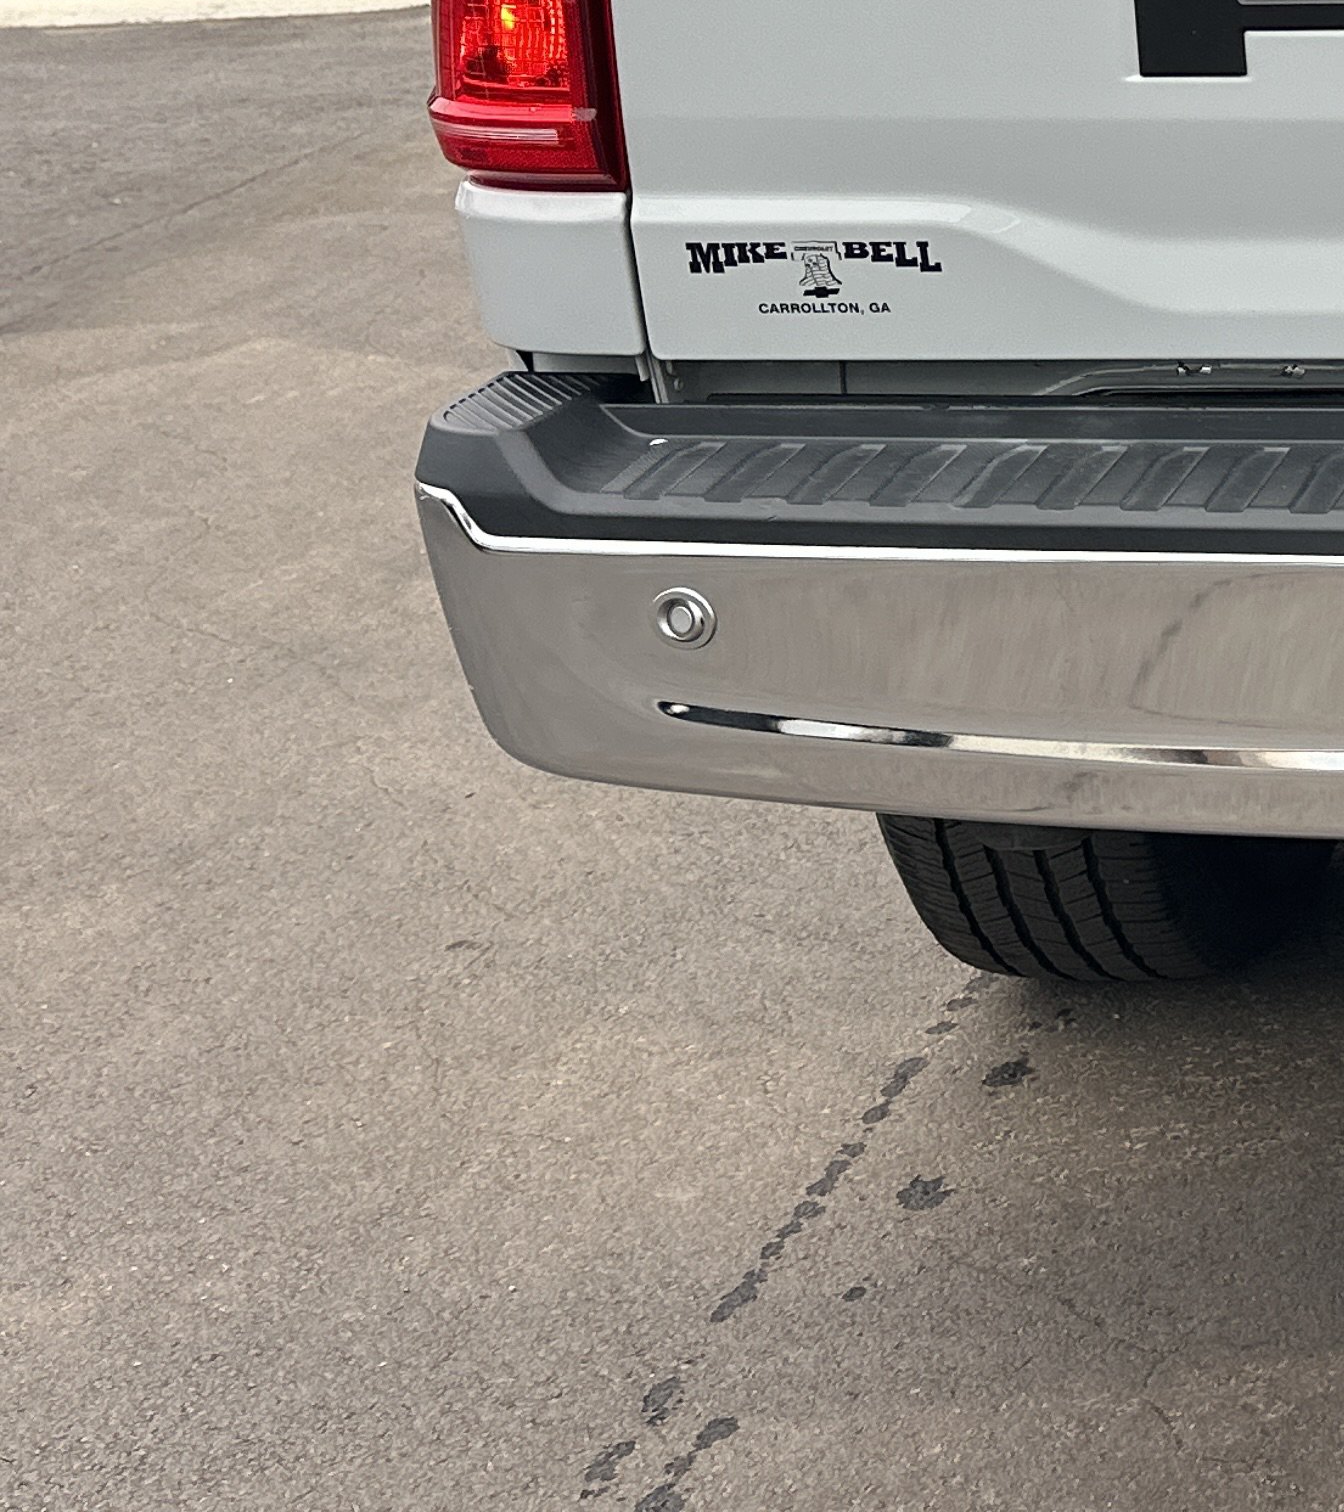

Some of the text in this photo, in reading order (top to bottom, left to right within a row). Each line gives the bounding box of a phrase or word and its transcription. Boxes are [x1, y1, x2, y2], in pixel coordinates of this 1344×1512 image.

[685, 241, 942, 273] MIKE BELL
[758, 302, 891, 315] CARROLLTON, GA
